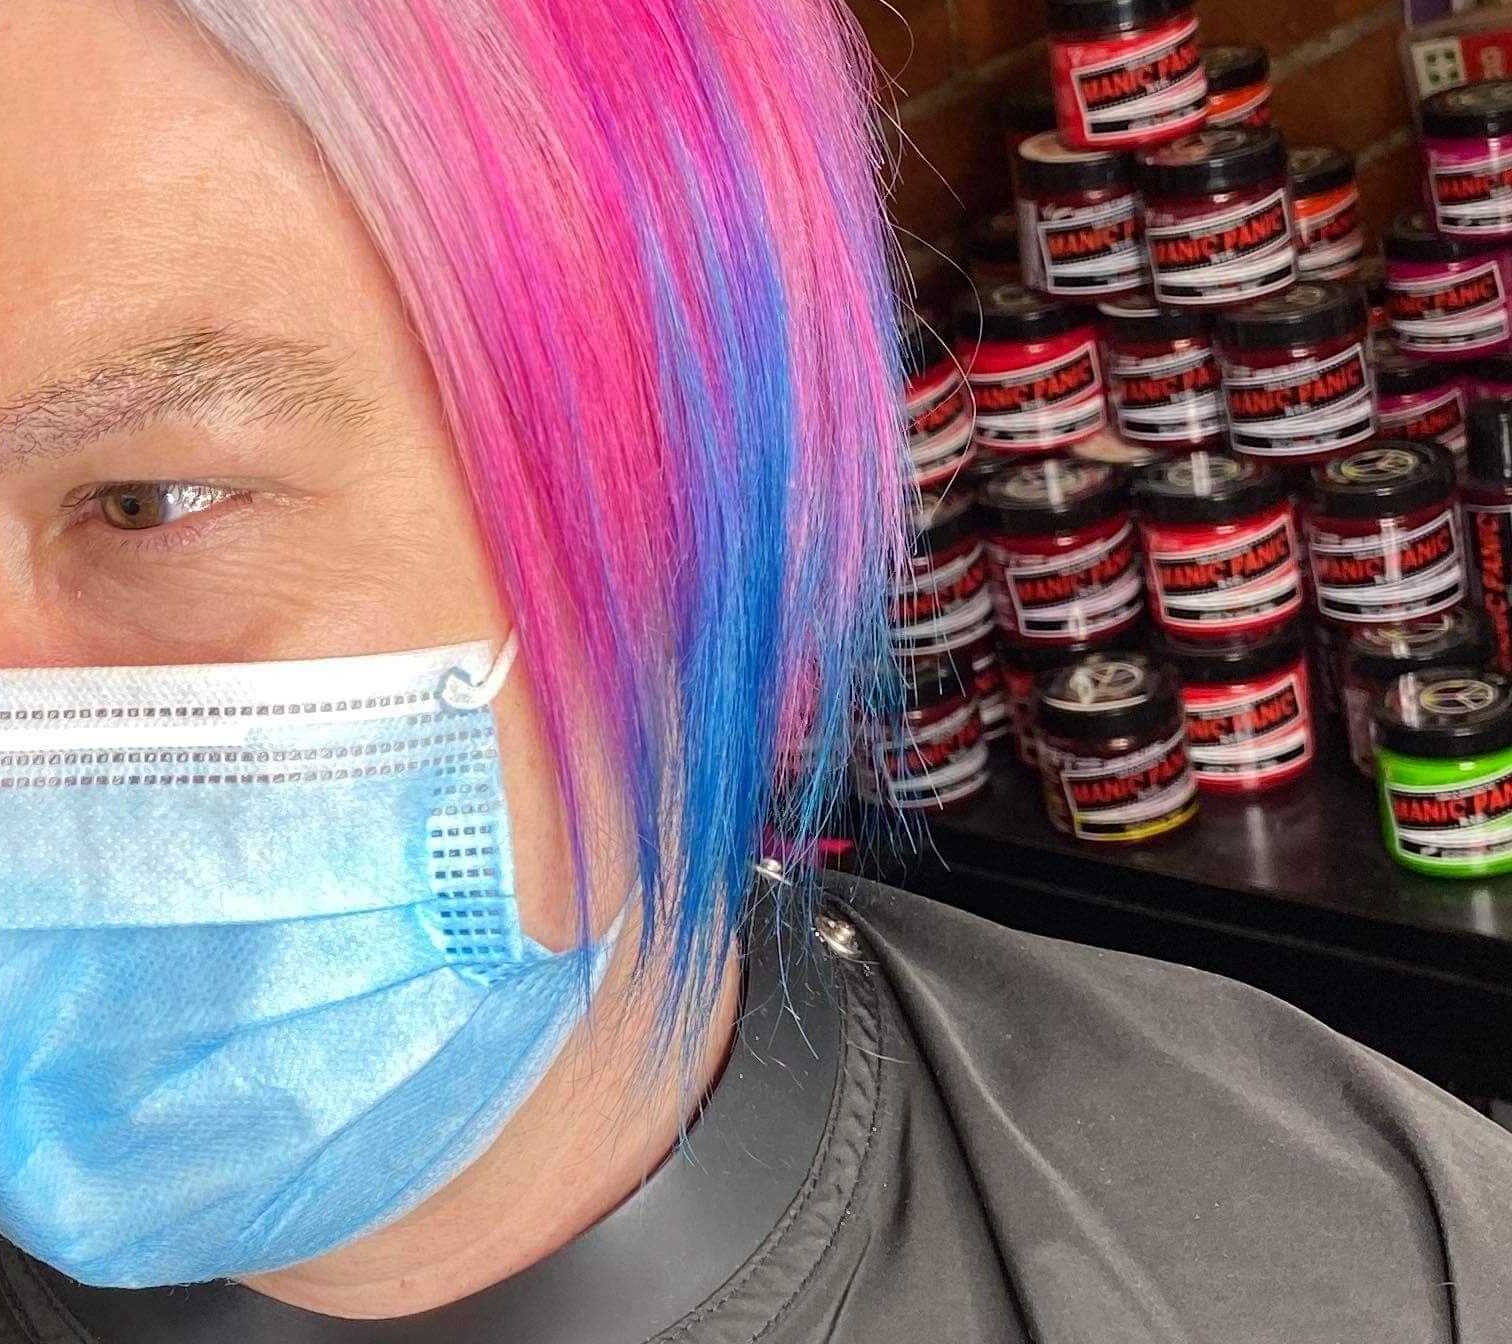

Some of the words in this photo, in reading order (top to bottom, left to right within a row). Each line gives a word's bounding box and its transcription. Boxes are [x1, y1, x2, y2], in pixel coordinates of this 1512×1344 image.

[1223, 208, 1285, 250] PANIC
[1299, 358, 1362, 406] PANIC
[1230, 530, 1290, 577] PANIC
